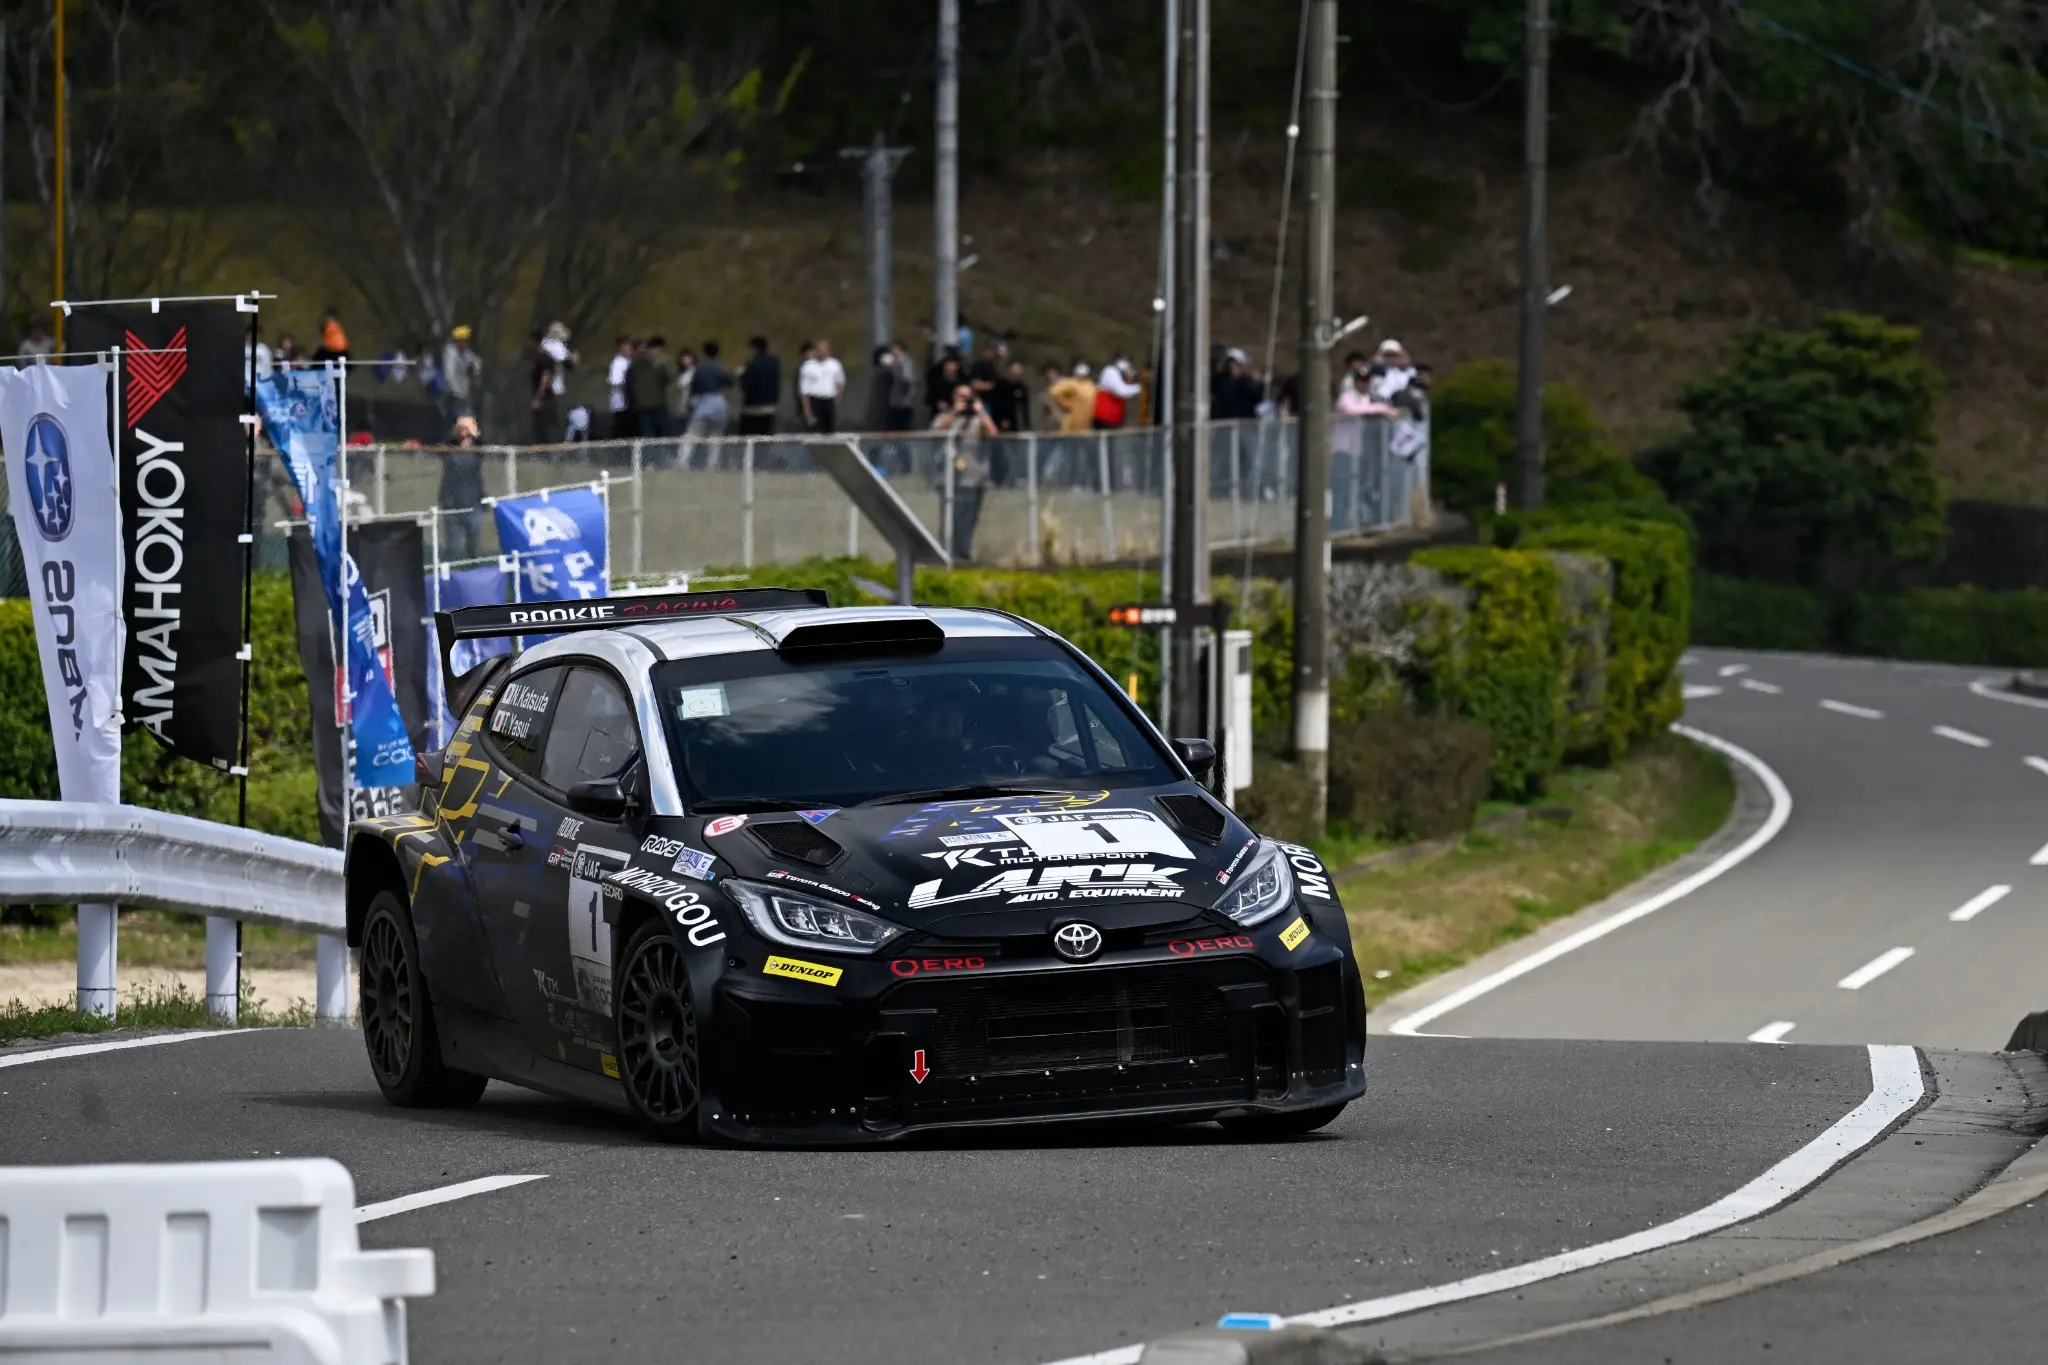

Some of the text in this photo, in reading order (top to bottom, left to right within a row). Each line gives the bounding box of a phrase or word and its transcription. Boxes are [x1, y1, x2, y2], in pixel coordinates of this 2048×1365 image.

[510, 605, 615, 624] ROOKIE
[509, 684, 549, 713] N.Katsuta
[501, 711, 532, 739] T.Yasui
[1046, 813, 1085, 823] JAF
[1081, 822, 1121, 844] 1
[640, 834, 685, 858] RAYS
[584, 859, 601, 879] JAF
[999, 852, 1149, 865] MOTORSPORT
[785, 874, 819, 887] TOYOTA
[819, 883, 851, 897] GAZOO
[1006, 888, 1186, 905] AUTO EQUIPMENT
[589, 889, 598, 953] 1
[779, 963, 835, 979] DUNLOP
